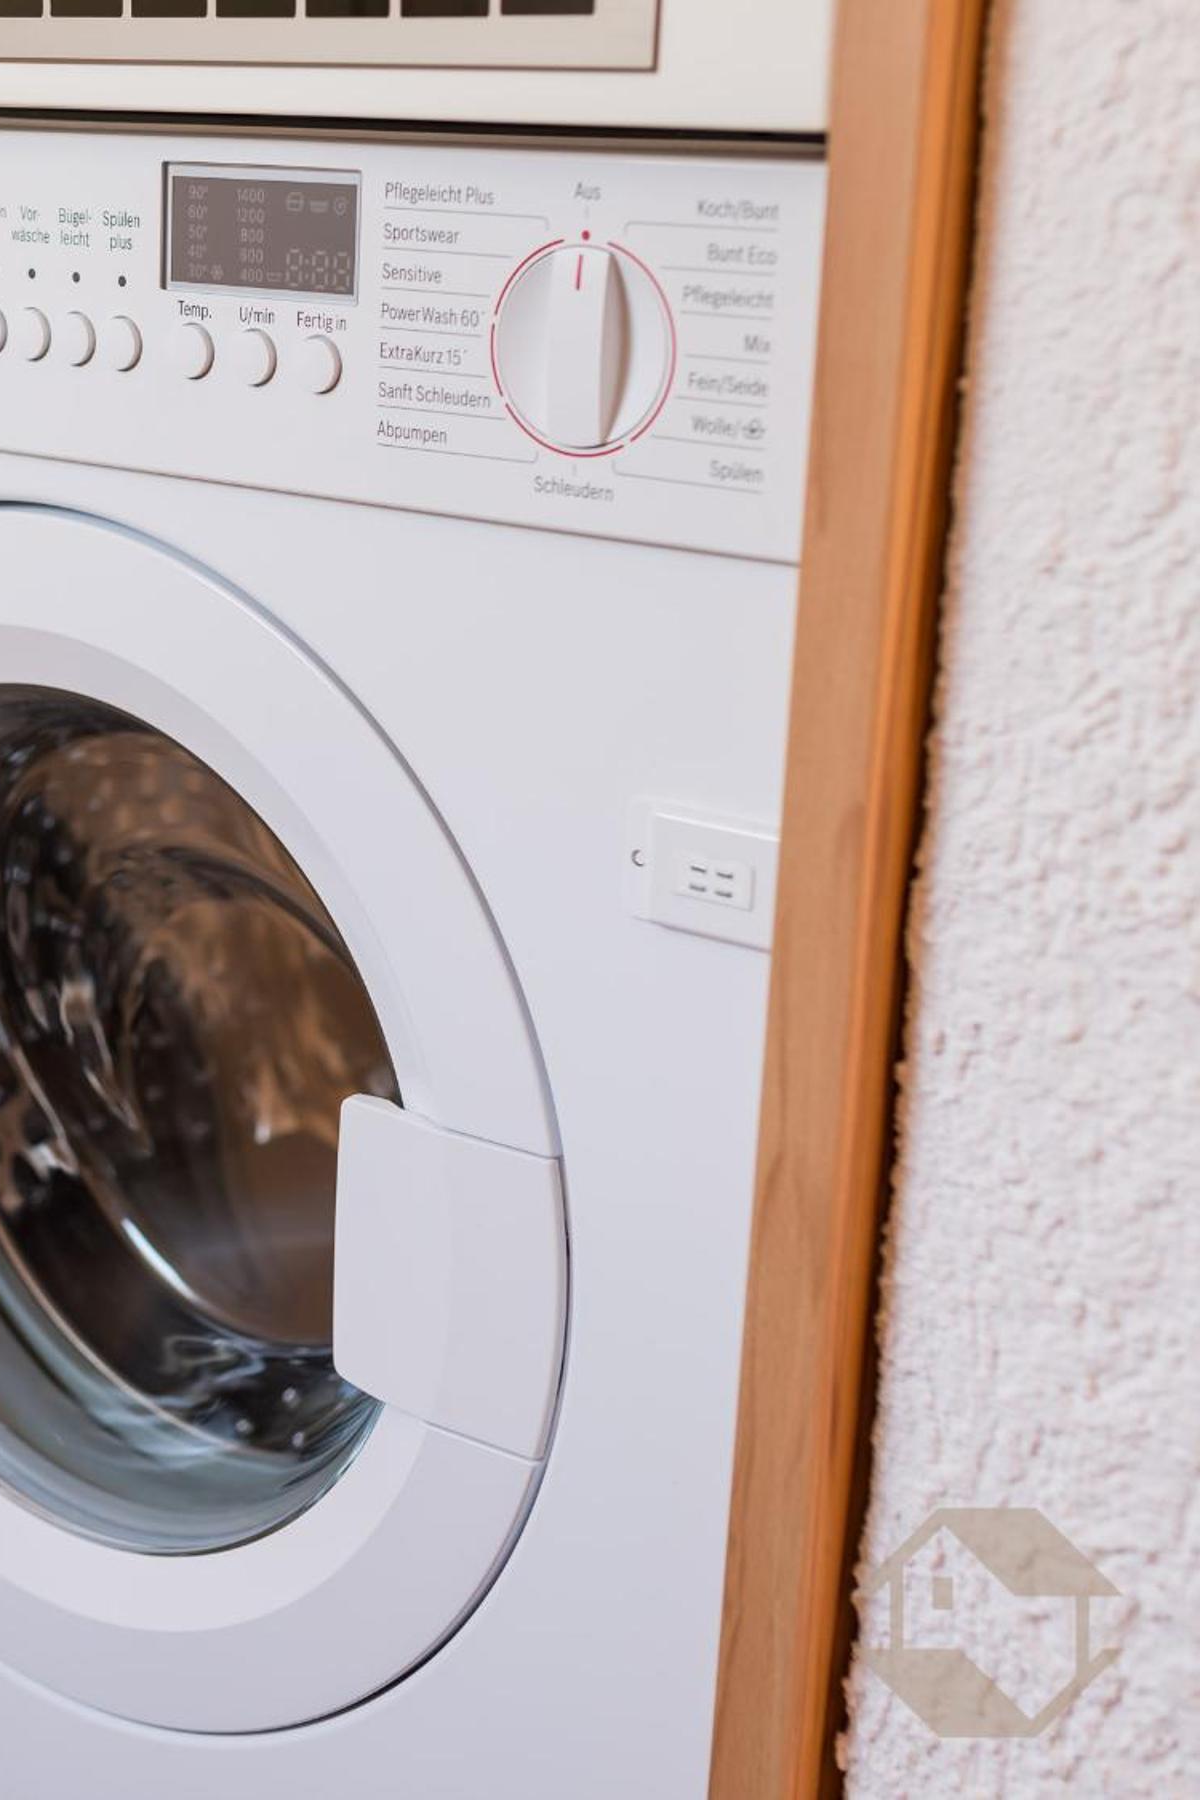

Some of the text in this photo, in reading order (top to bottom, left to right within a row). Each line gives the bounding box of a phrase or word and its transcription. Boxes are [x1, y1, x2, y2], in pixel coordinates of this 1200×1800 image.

[384, 182, 495, 206] Pflegeleicht Plus
[573, 181, 601, 201] Aus
[19, 205, 41, 222] Vor-
[58, 207, 93, 228] Bügel-
[102, 210, 141, 229] Spülen
[697, 199, 780, 221] Koch/Bunt
[10, 228, 51, 245] wäsche
[59, 231, 91, 249] leicht
[109, 233, 133, 252] plus
[383, 222, 460, 244] Sportswear
[706, 242, 778, 266] Bunt Eco
[382, 262, 443, 284] Sensitive
[682, 284, 775, 310] Pflegeleicht
[177, 300, 213, 321] Temp.
[239, 306, 275, 325] U/min
[296, 310, 348, 333] Fertig in
[379, 341, 444, 365] ExtraKurz
[744, 335, 771, 352] Mix
[378, 381, 492, 409] Sanft Schleudern
[688, 371, 769, 398] Fein/Seide
[376, 420, 448, 445] Abpumpen
[708, 459, 765, 483] Spülen
[533, 475, 615, 502] Schleudern
